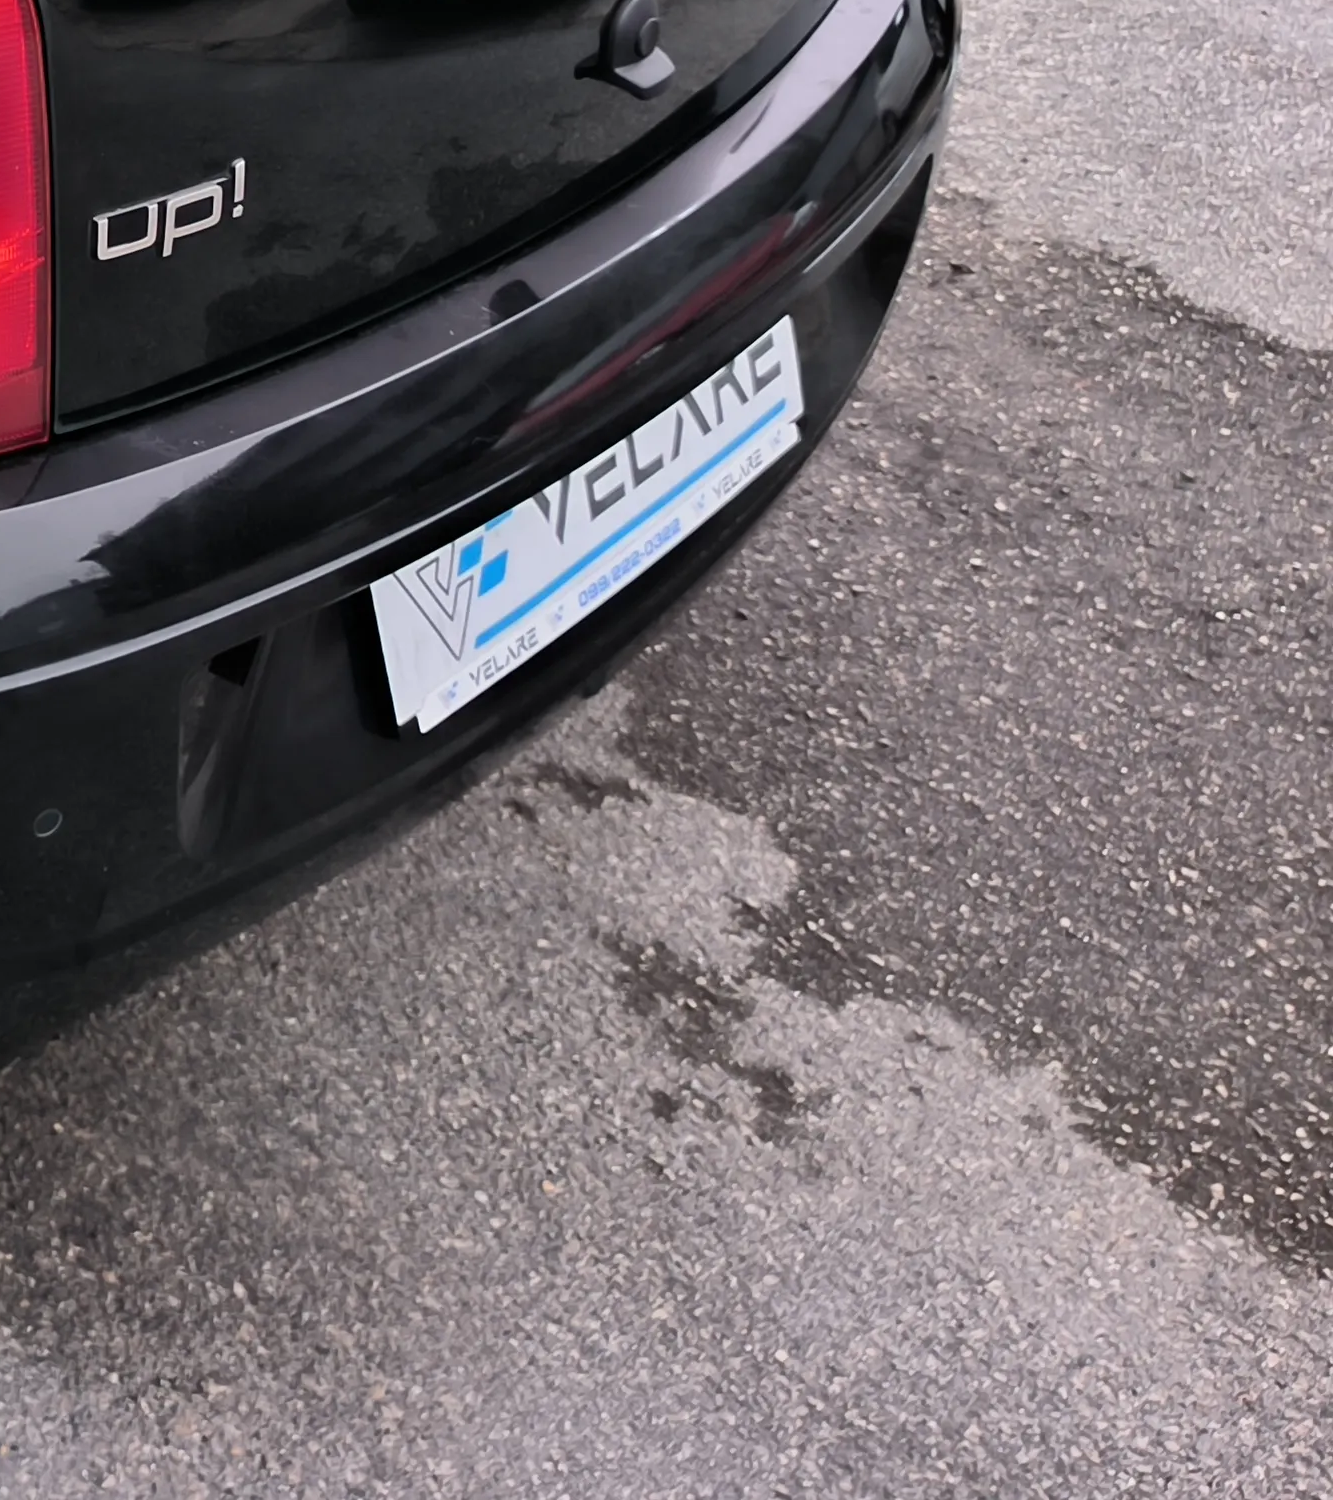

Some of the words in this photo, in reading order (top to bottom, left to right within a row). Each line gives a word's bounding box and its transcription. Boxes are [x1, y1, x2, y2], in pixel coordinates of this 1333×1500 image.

[93, 156, 246, 261] up!
[469, 626, 539, 687] VELARE
[712, 447, 764, 499] VELARE
